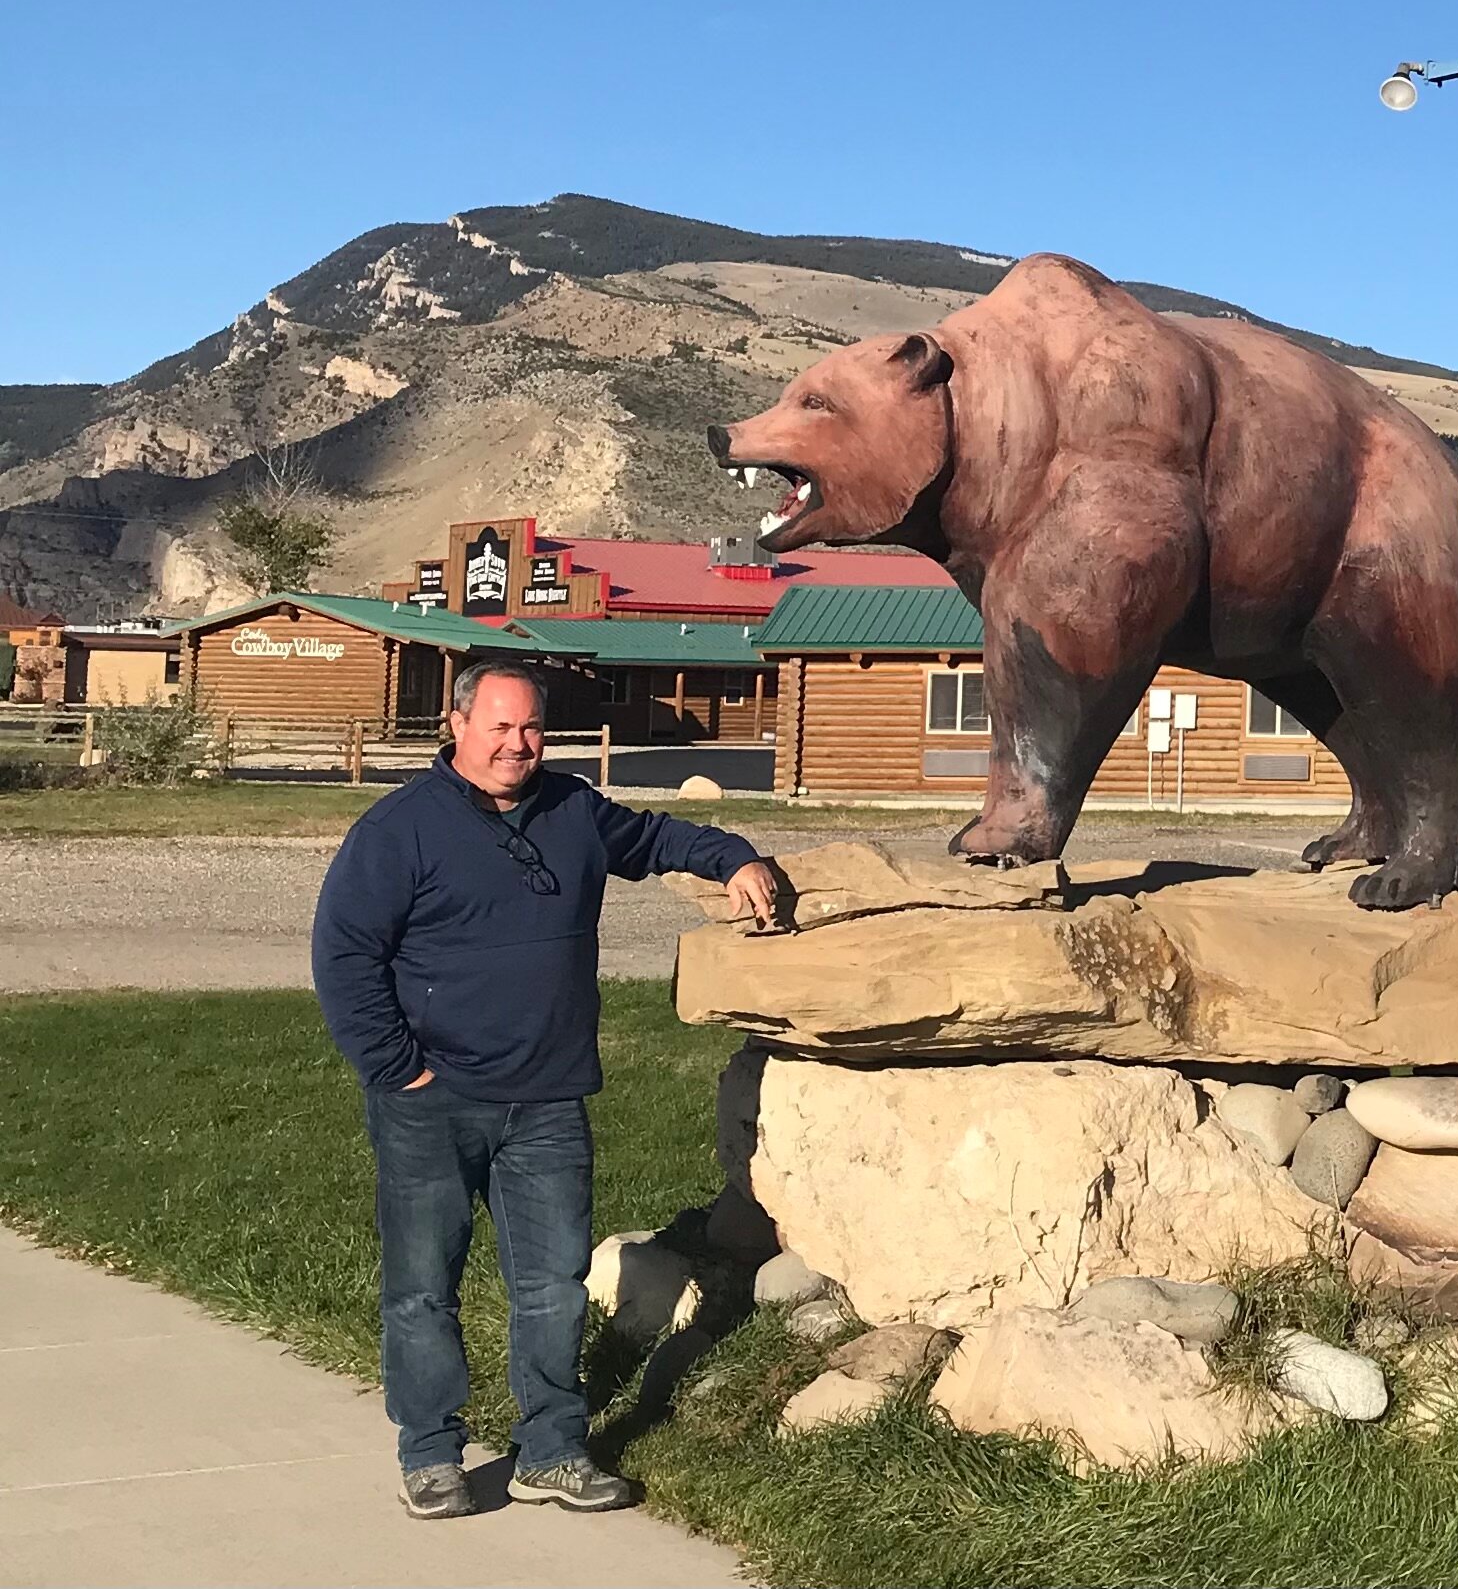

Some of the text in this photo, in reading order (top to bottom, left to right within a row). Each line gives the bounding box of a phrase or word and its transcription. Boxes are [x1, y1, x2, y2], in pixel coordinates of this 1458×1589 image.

[240, 627, 268, 642] Cody
[231, 636, 345, 662] Cowboy Village
